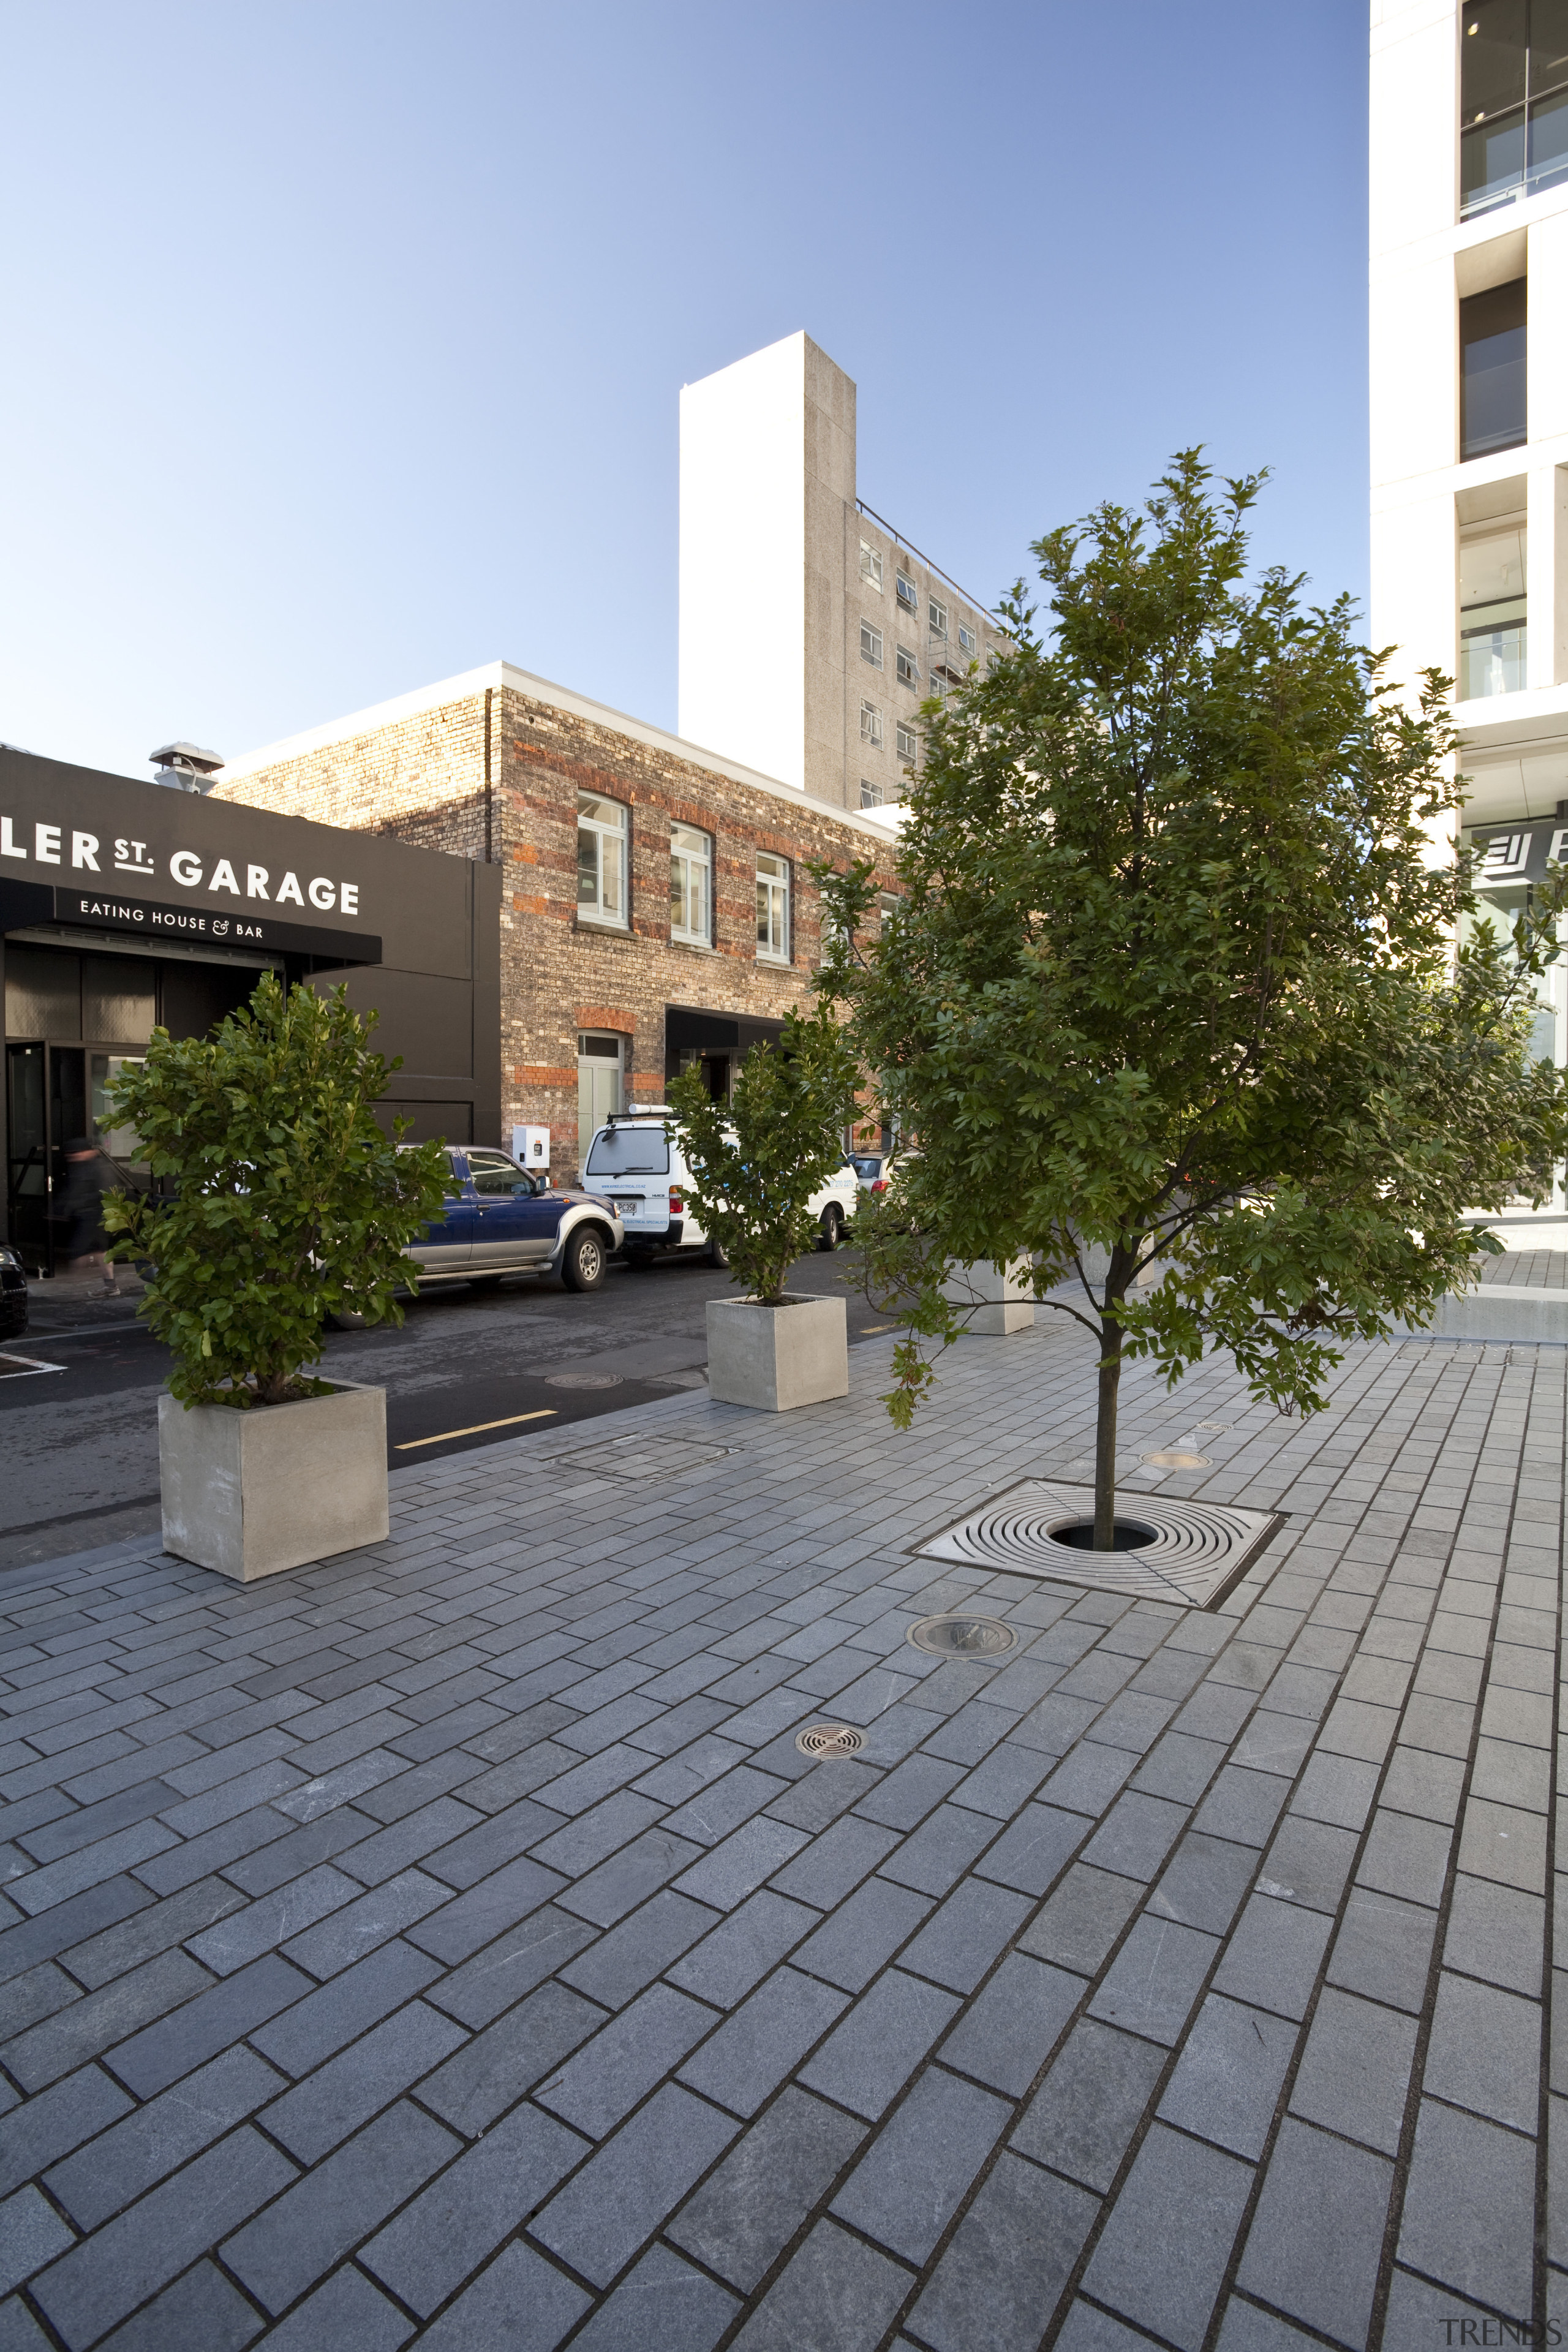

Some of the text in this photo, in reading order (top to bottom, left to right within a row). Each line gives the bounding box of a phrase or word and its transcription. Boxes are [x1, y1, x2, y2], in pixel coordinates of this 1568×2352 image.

[1, 816, 359, 916] LER ST. GARAGE
[80, 900, 263, 938] EATING HOUSE & BAR
